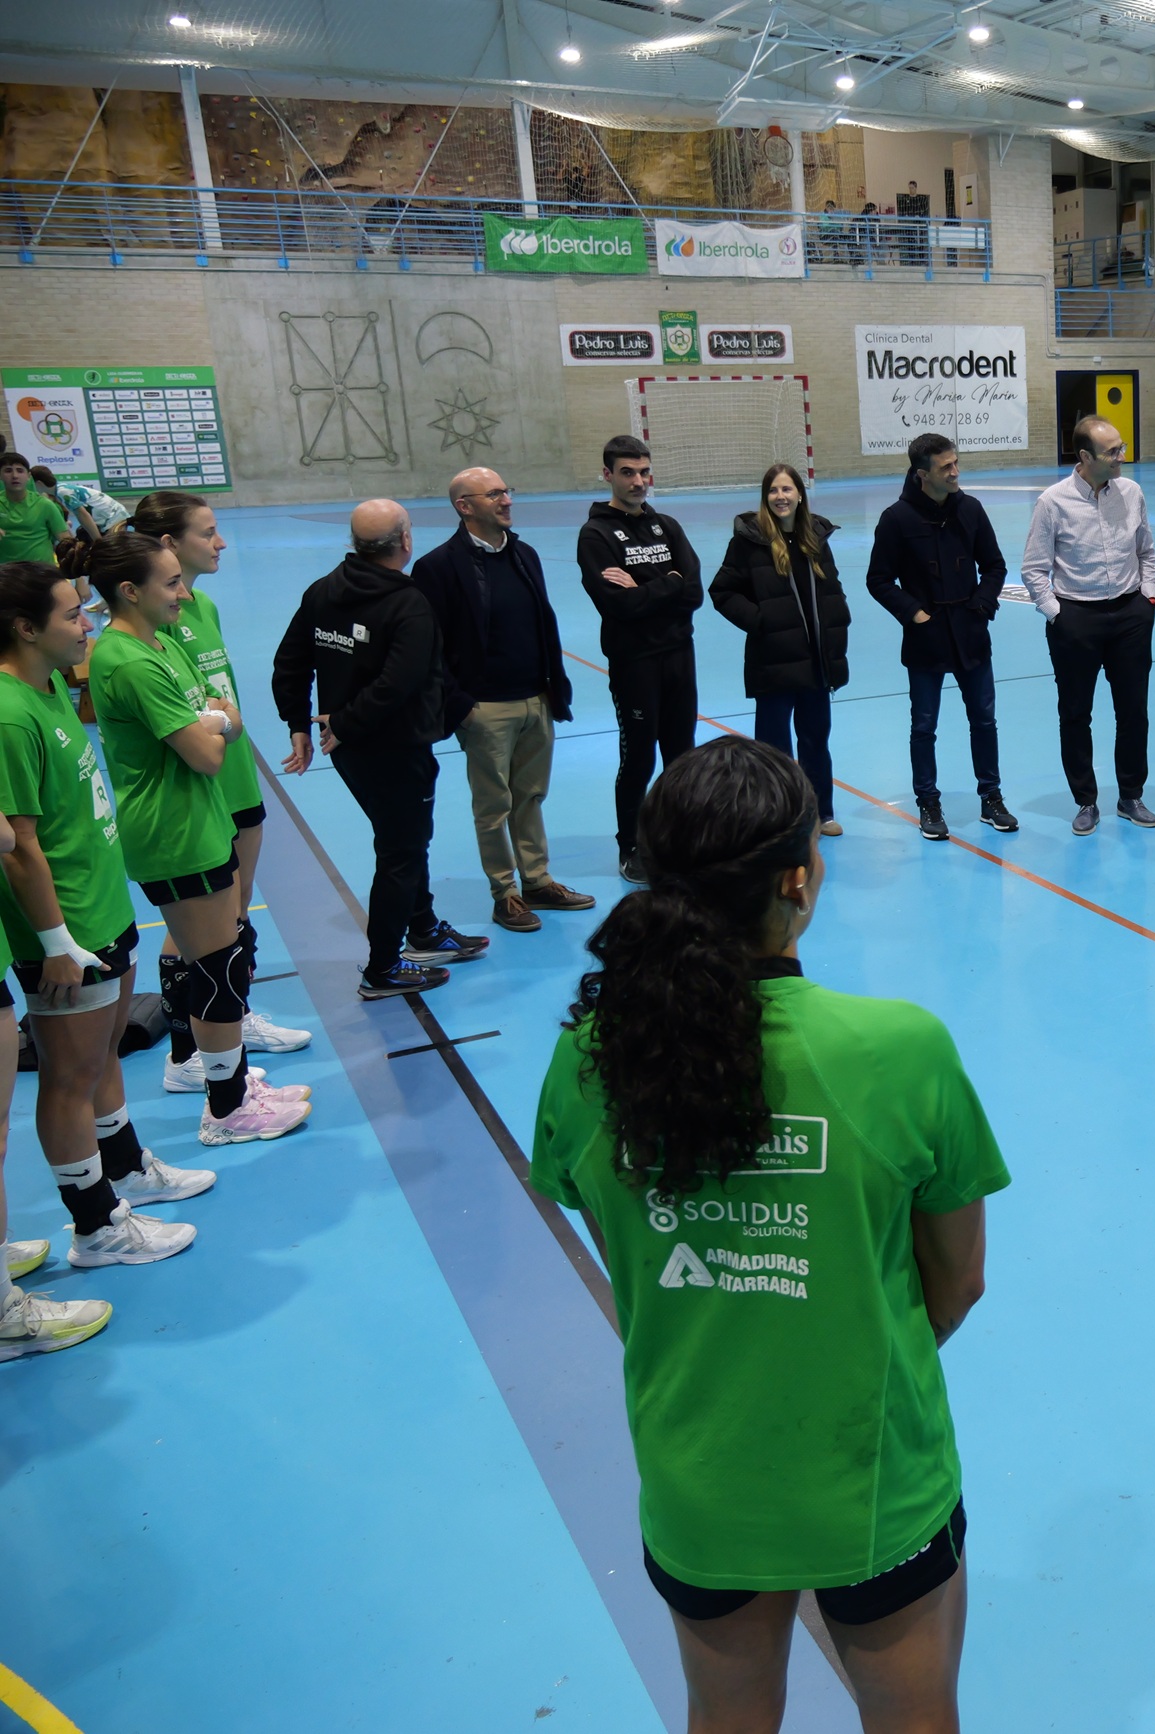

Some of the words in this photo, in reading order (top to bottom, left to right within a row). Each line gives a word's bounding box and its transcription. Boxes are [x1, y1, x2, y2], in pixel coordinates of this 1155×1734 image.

[539, 233, 632, 257] Iberdrola
[698, 240, 770, 259] Iberdrola
[574, 334, 614, 349] Pedro
[620, 334, 649, 349] Luis
[713, 334, 750, 348] Pedro
[754, 334, 781, 348] Luis
[864, 333, 899, 344] Clínica
[901, 333, 933, 344] Dental
[867, 350, 1017, 380] Macrodent
[892, 388, 910, 413] by
[913, 413, 936, 426] 948
[939, 413, 953, 426] 27
[958, 412, 972, 425] 28
[975, 412, 990, 425] 69
[315, 627, 355, 648] Replasa
[683, 1200, 809, 1227] SOLIDUS
[742, 1225, 808, 1240] SOLUTIONS
[705, 1248, 809, 1276] ARMADURAS
[718, 1272, 808, 1299] ATARRABIA
